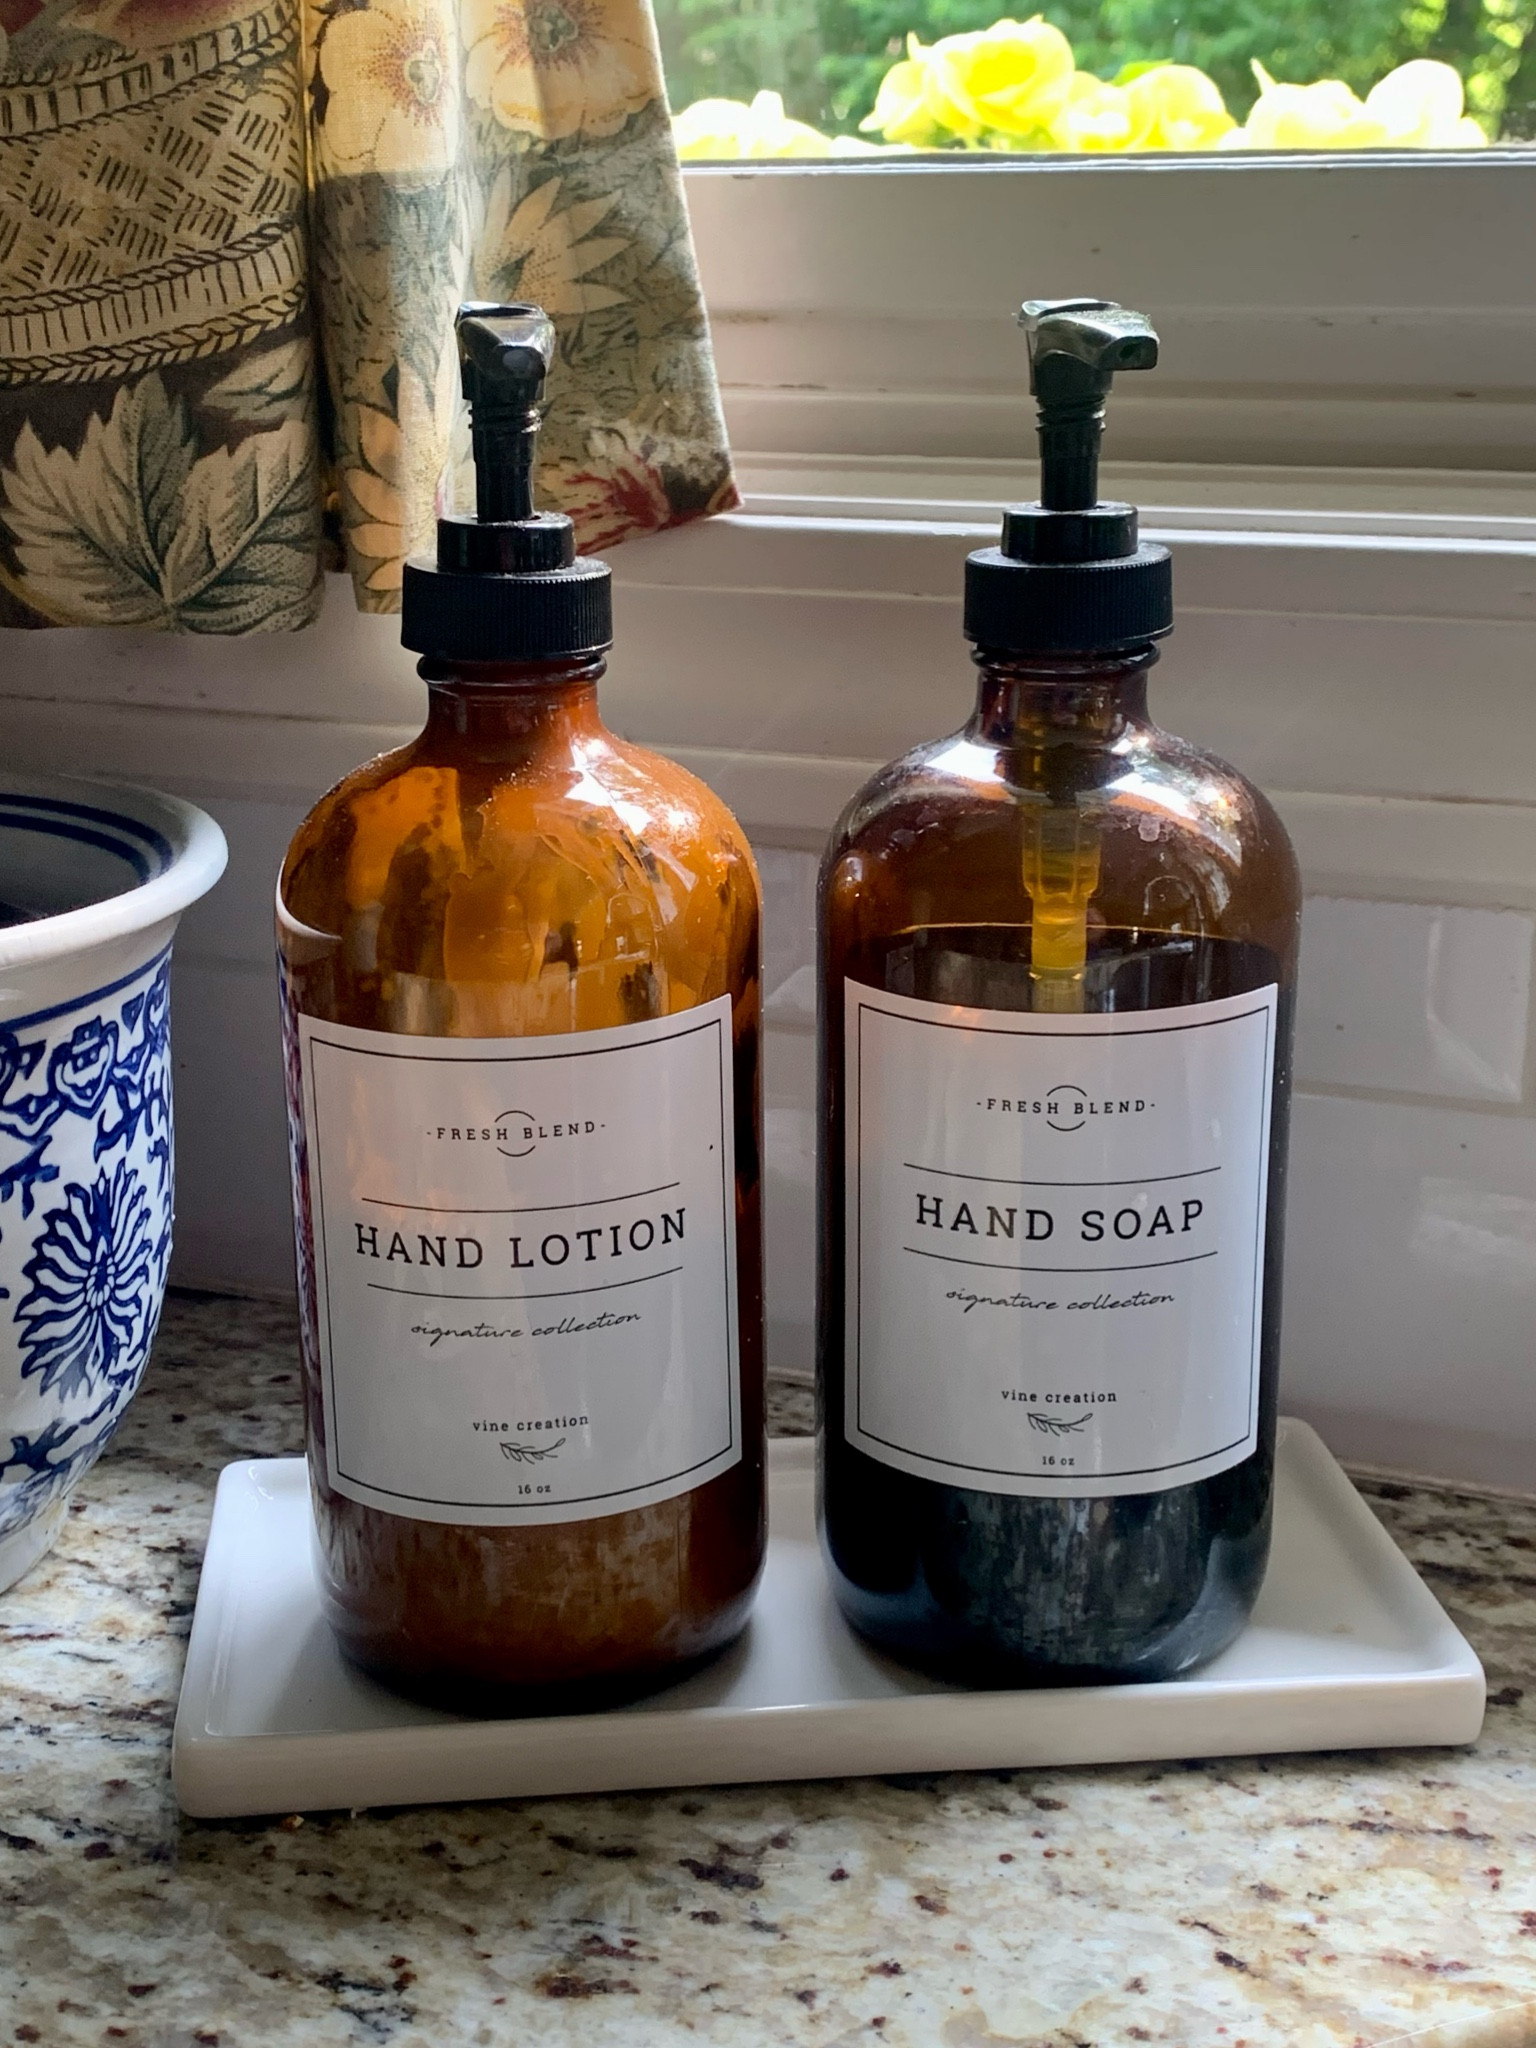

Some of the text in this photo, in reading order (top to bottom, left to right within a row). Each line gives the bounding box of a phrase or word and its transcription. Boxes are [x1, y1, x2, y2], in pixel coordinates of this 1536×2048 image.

[916, 1194, 1204, 1241] HAND SOAP
[356, 1208, 687, 1268] HAND LOTION
[946, 1289, 1174, 1312] signature collection
[411, 1312, 641, 1346] signature collection
[1001, 1389, 1117, 1403] vine creation
[473, 1414, 589, 1432] vine creation
[1042, 1456, 1075, 1466] 16 oz
[518, 1484, 551, 1494] 16 oz
